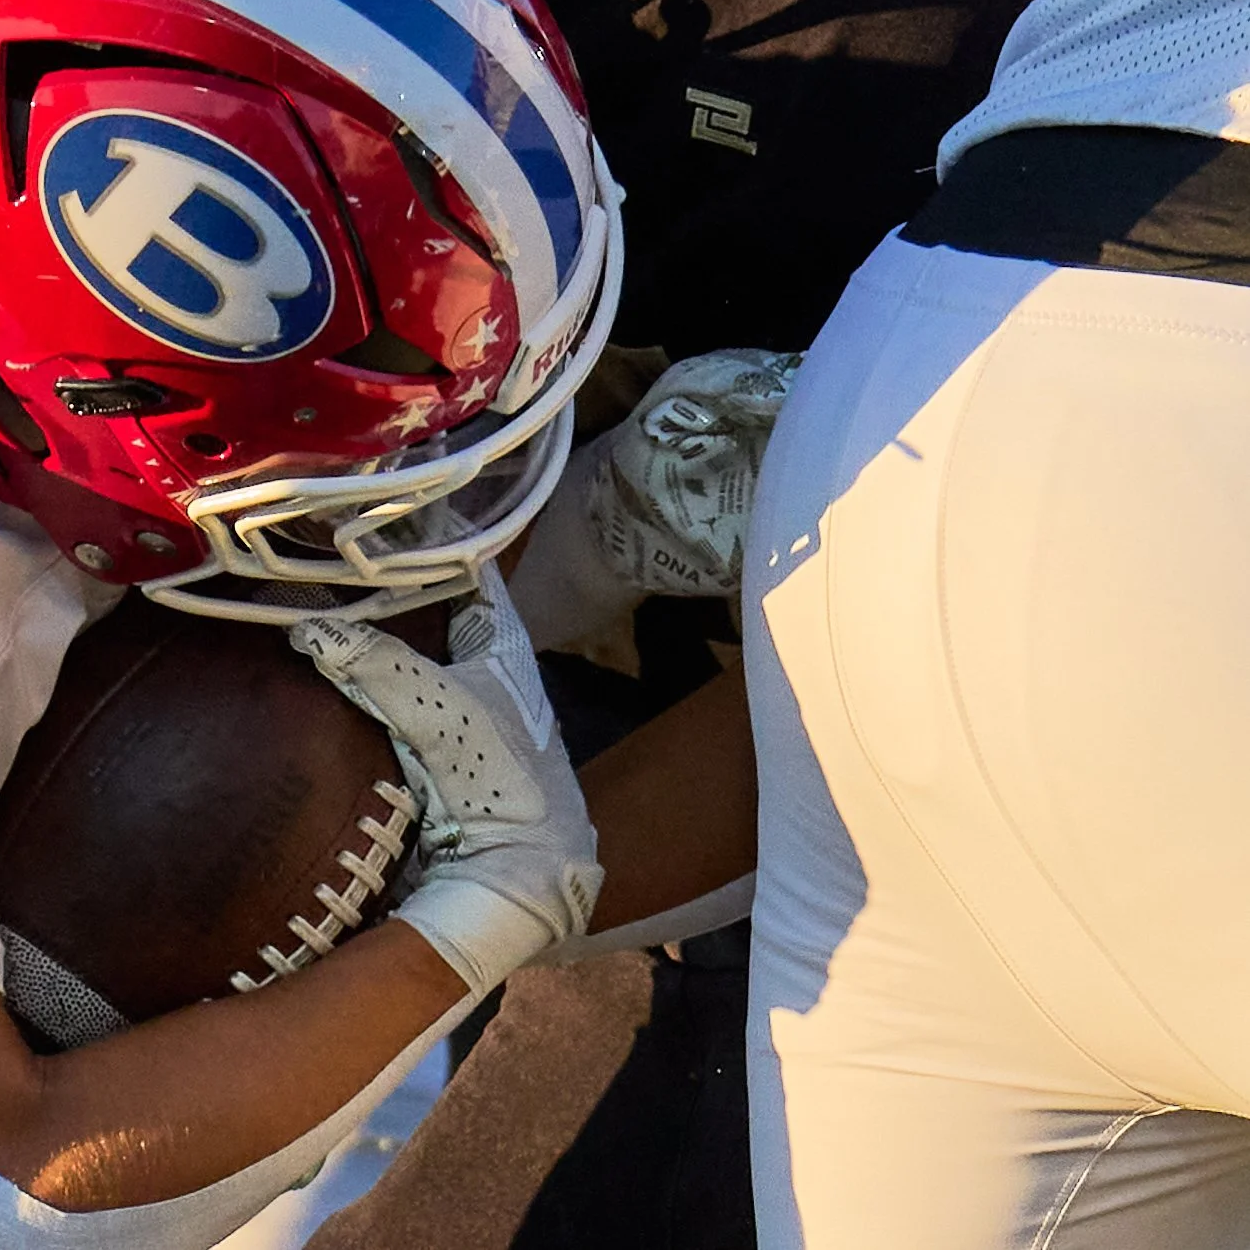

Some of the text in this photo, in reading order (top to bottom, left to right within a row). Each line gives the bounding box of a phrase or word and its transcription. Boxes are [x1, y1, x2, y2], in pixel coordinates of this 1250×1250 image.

[58, 137, 312, 350] B
[653, 550, 701, 587] DNA
[308, 617, 350, 647] JUMP
